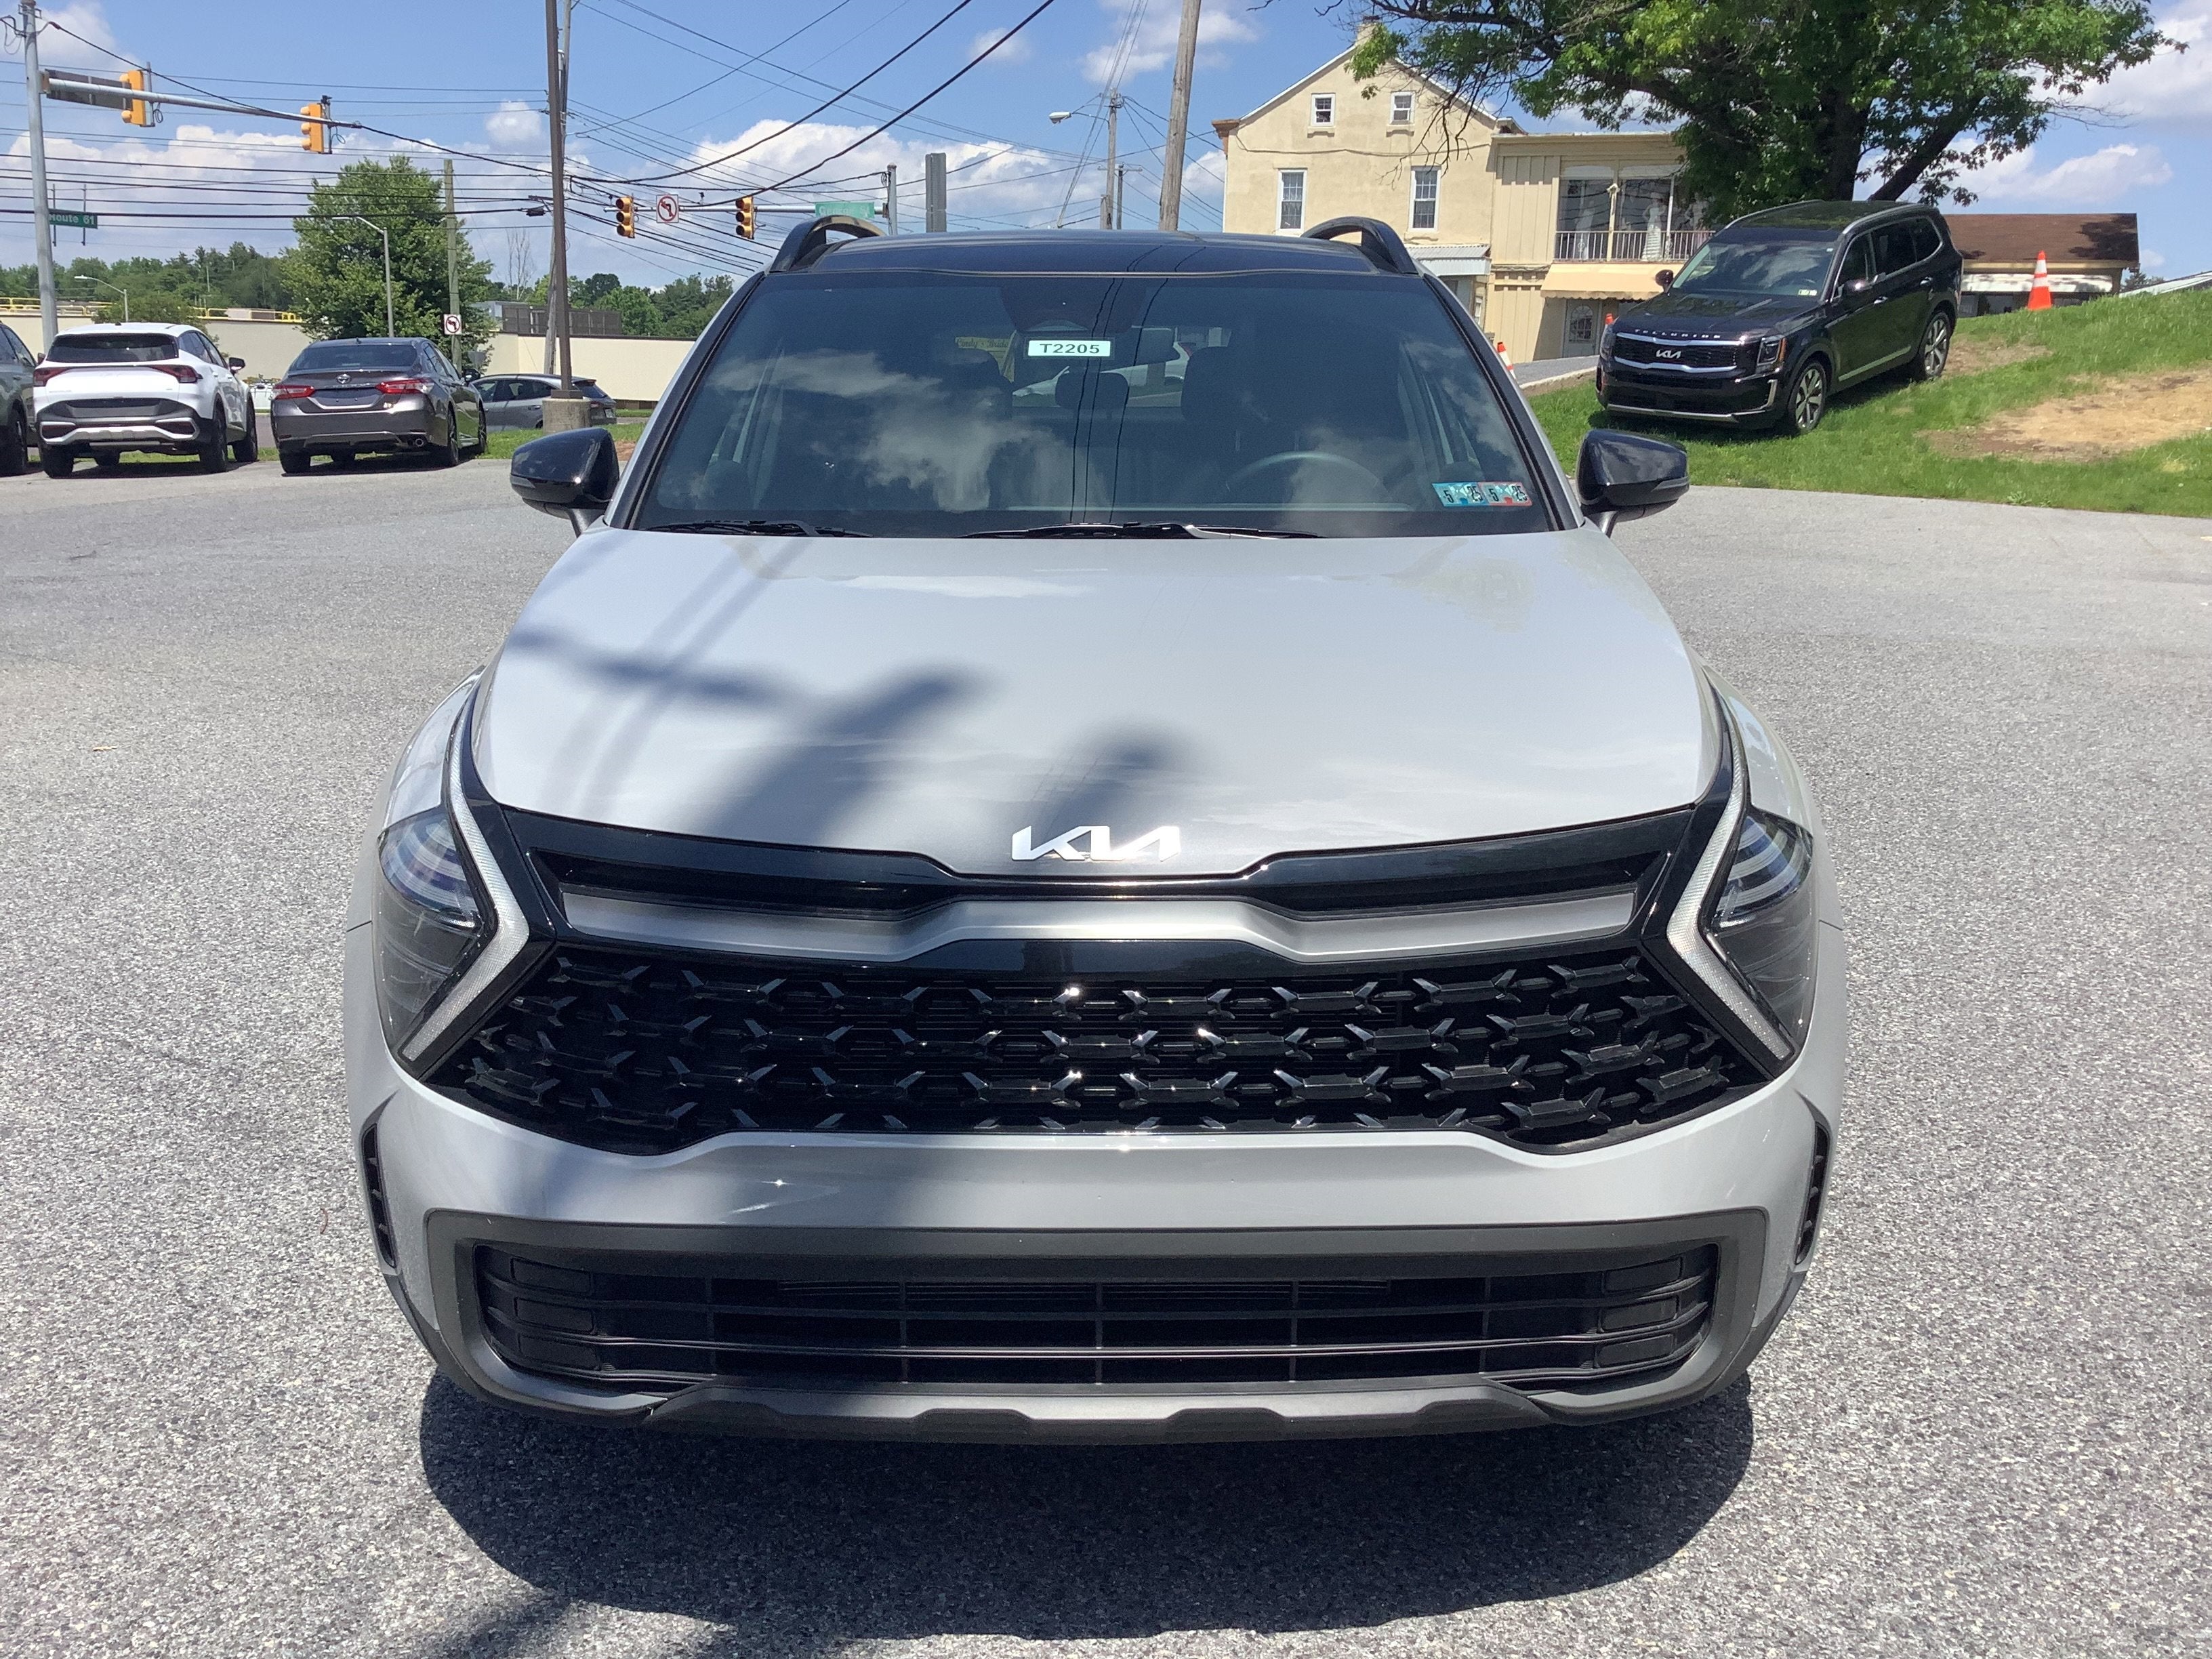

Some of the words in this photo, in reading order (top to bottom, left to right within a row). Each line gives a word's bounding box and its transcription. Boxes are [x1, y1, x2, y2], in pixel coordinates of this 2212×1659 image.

[49, 213, 79, 224] Route
[83, 215, 95, 225] 61
[1039, 344, 1101, 354] T2205
[1656, 349, 1681, 359] KIA
[1467, 485, 1484, 501] 25
[1512, 485, 1528, 501] 25
[1011, 825, 1181, 862] KIA
